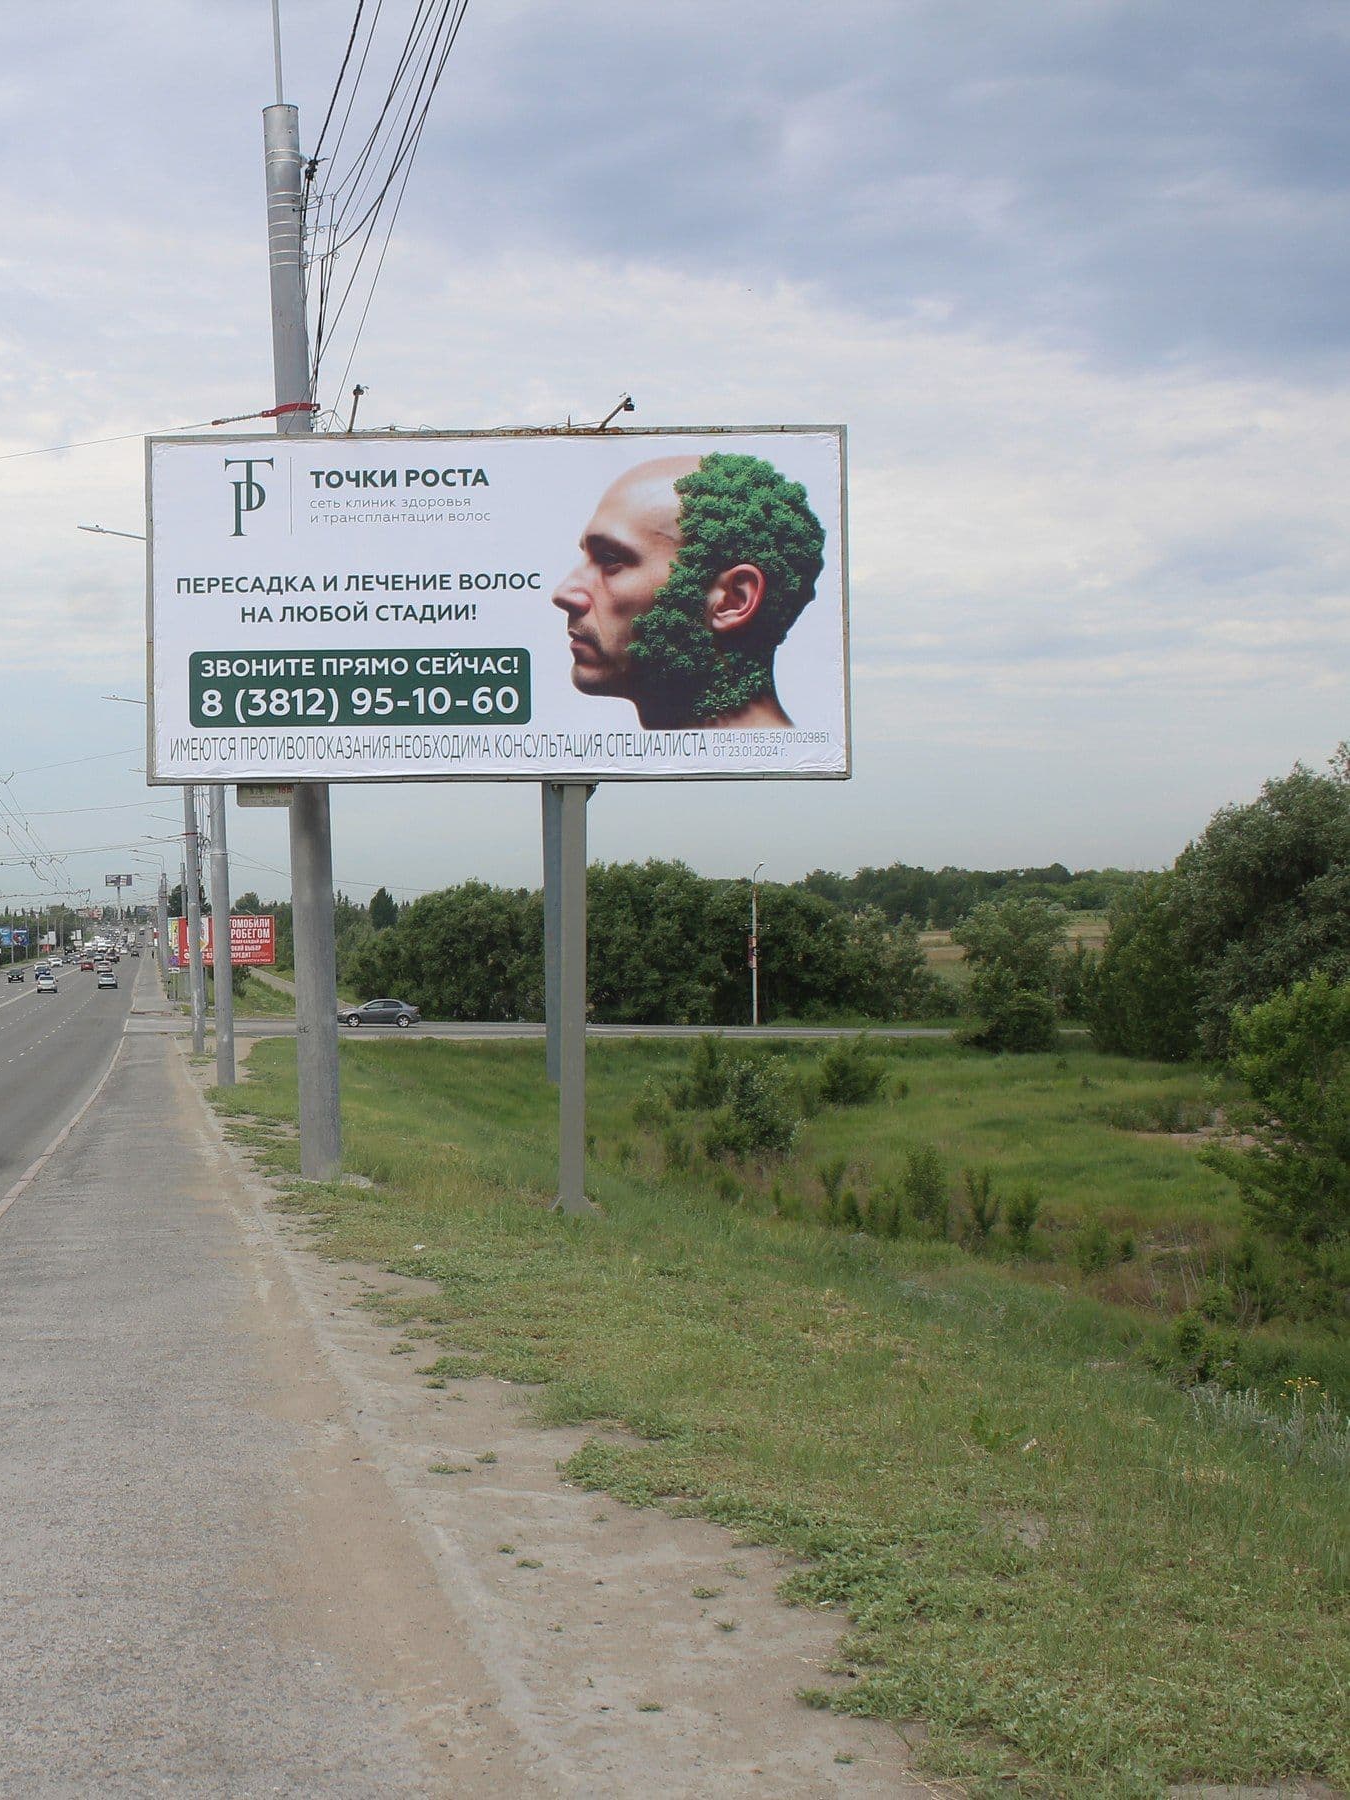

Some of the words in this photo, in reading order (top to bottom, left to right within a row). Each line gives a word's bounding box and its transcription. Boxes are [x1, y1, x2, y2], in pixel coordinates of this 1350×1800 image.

[309, 469, 398, 489] ТОЧКИ
[405, 468, 490, 488] РОСТА
[309, 499, 341, 509] сеть
[346, 498, 396, 508] клиник
[401, 497, 472, 510] здоровья
[310, 514, 319, 524] и
[323, 512, 444, 526] трансплантации
[448, 512, 491, 523] волос
[176, 575, 317, 596] ПЕРЕСАДКА
[323, 575, 339, 593] И
[344, 573, 453, 592] ЛЕЧЕНИЕ
[458, 572, 542, 591] ВОЛОС
[241, 605, 273, 624] НА
[279, 600, 368, 623] ЛЮБОЙ
[375, 603, 478, 625] СТАДИИ!
[200, 658, 316, 678] ЗВОНИТЕ
[322, 656, 409, 676] ПРЯМО
[415, 652, 520, 675] СЕЙЧАС!
[200, 688, 224, 717] 8
[234, 686, 340, 724] (3812)
[351, 685, 520, 716] 95-10-60
[169, 736, 237, 762] ИМЕЮТСЯ
[494, 733, 602, 763] КОНСУЛЬТАЦИЯ
[606, 732, 707, 762] СПЕЦИАЛИСТА
[712, 746, 726, 757] ОТ
[728, 746, 778, 757] 23.01.2024
